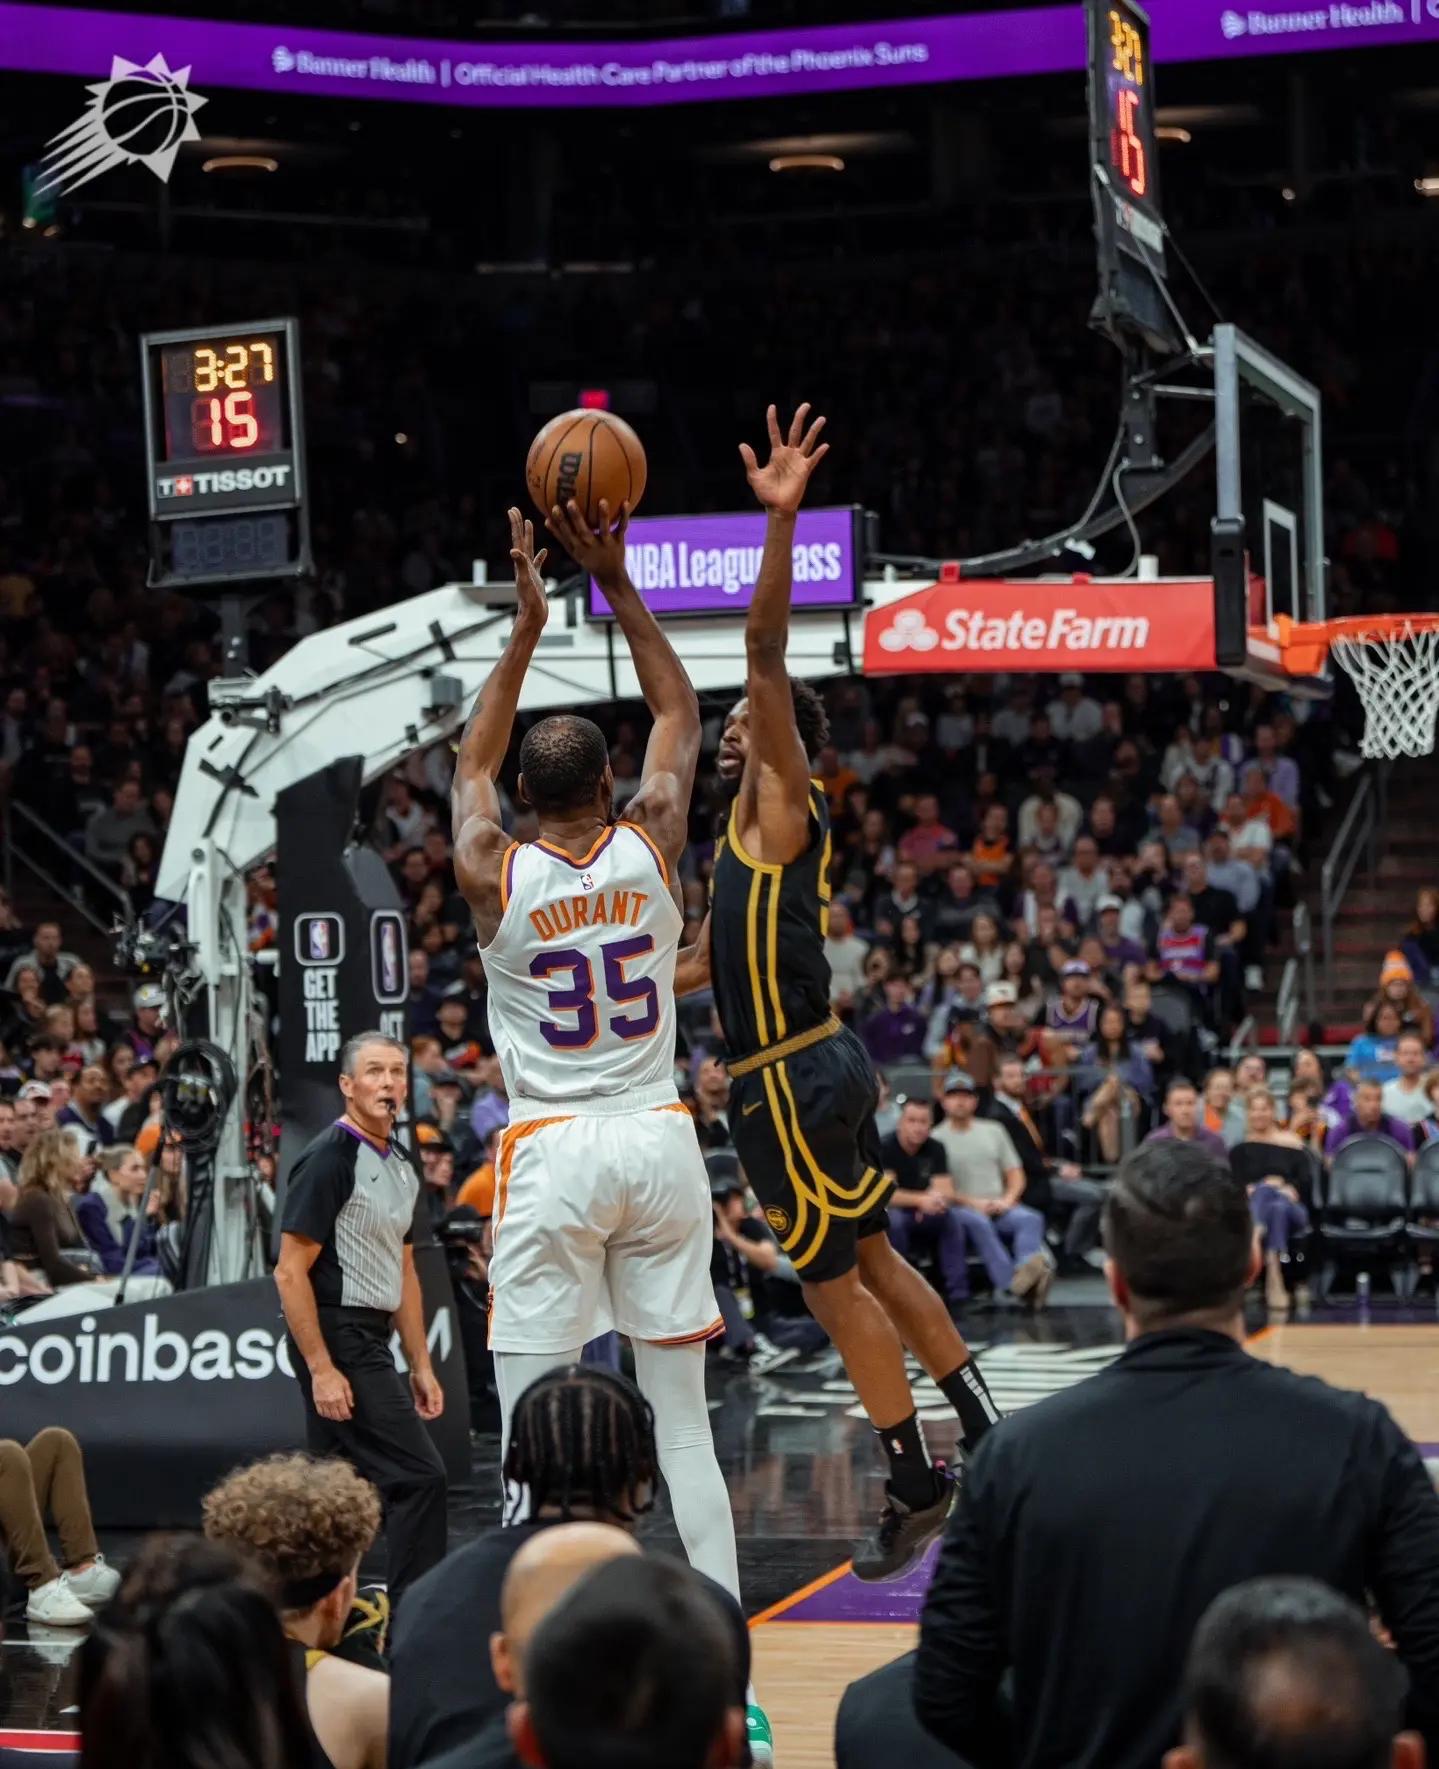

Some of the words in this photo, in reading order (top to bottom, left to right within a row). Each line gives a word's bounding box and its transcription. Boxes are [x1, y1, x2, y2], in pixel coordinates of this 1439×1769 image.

[1248, 10, 1328, 35] Banner
[1329, 0, 1404, 28] Health
[296, 50, 368, 79] Banner
[369, 56, 436, 84] Health
[454, 61, 526, 86] Official
[527, 63, 599, 86] Health
[600, 61, 651, 86] Care
[652, 59, 727, 83] Partner
[728, 52, 755, 78] of
[755, 51, 791, 76] the
[790, 45, 874, 72] Phoenix
[874, 41, 929, 65] Suns
[194, 342, 274, 392] 3:27
[209, 390, 259, 448] 15
[193, 464, 291, 495] TISSOT
[624, 543, 677, 590] NBA
[678, 541, 764, 594] Leagu
[792, 542, 842, 582] ass
[941, 609, 1047, 651] State
[1047, 608, 1150, 649] Farm
[528, 890, 649, 943] DURANT
[303, 967, 338, 999] GET
[528, 933, 661, 1052] 35
[303, 999, 340, 1031] THE
[305, 1031, 341, 1063] APP
